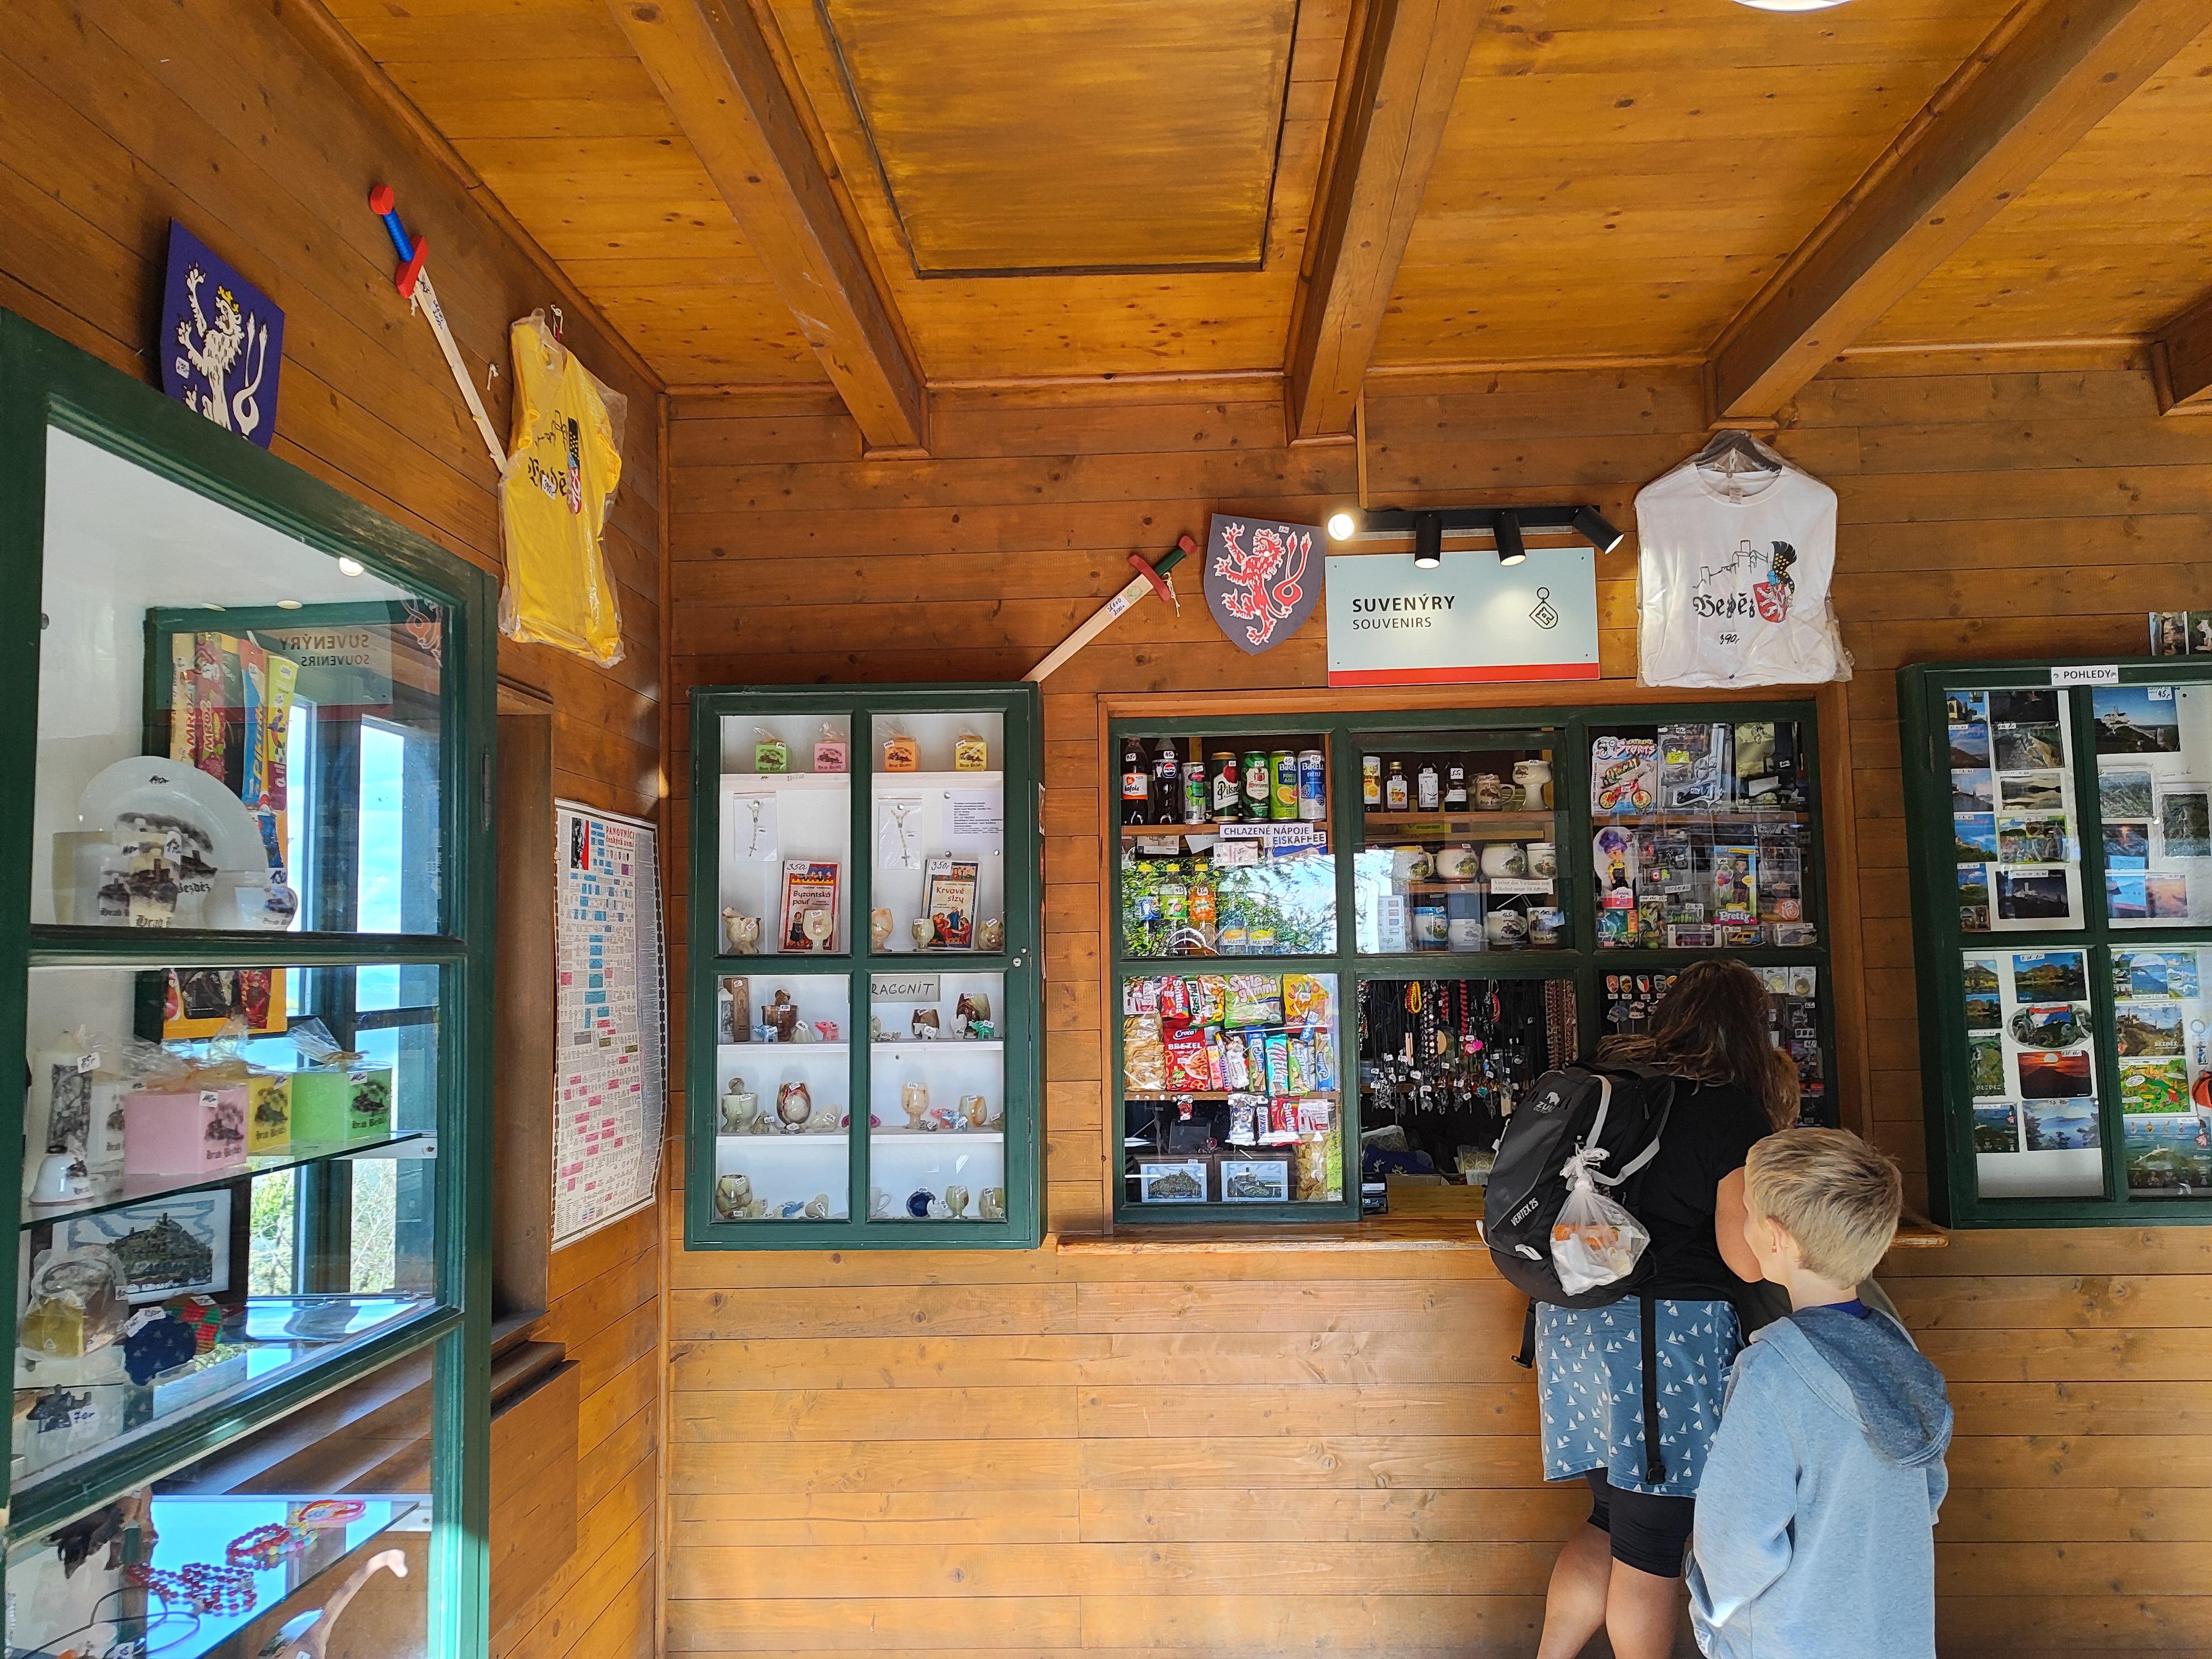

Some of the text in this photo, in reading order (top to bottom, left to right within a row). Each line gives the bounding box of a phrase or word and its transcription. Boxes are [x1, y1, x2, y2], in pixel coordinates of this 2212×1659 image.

[1353, 593, 1455, 612] SUVENÝRY
[1353, 617, 1431, 630] SOUVENIRS
[2064, 669, 2111, 679] POHLEDY
[1224, 825, 1310, 836] CHLAZENÉ NÁPOJE
[1272, 833, 1324, 845] EISKAFFEE
[1719, 911, 1750, 924] Pretty
[1229, 975, 1263, 992] Smile
[1172, 979, 1185, 1014] Skittles
[1174, 1030, 1194, 1038] Croco
[1168, 1042, 1202, 1050] BREZEL
[1220, 1055, 1229, 1088] mentos
[1510, 1197, 1539, 1227] VERTEX 25
